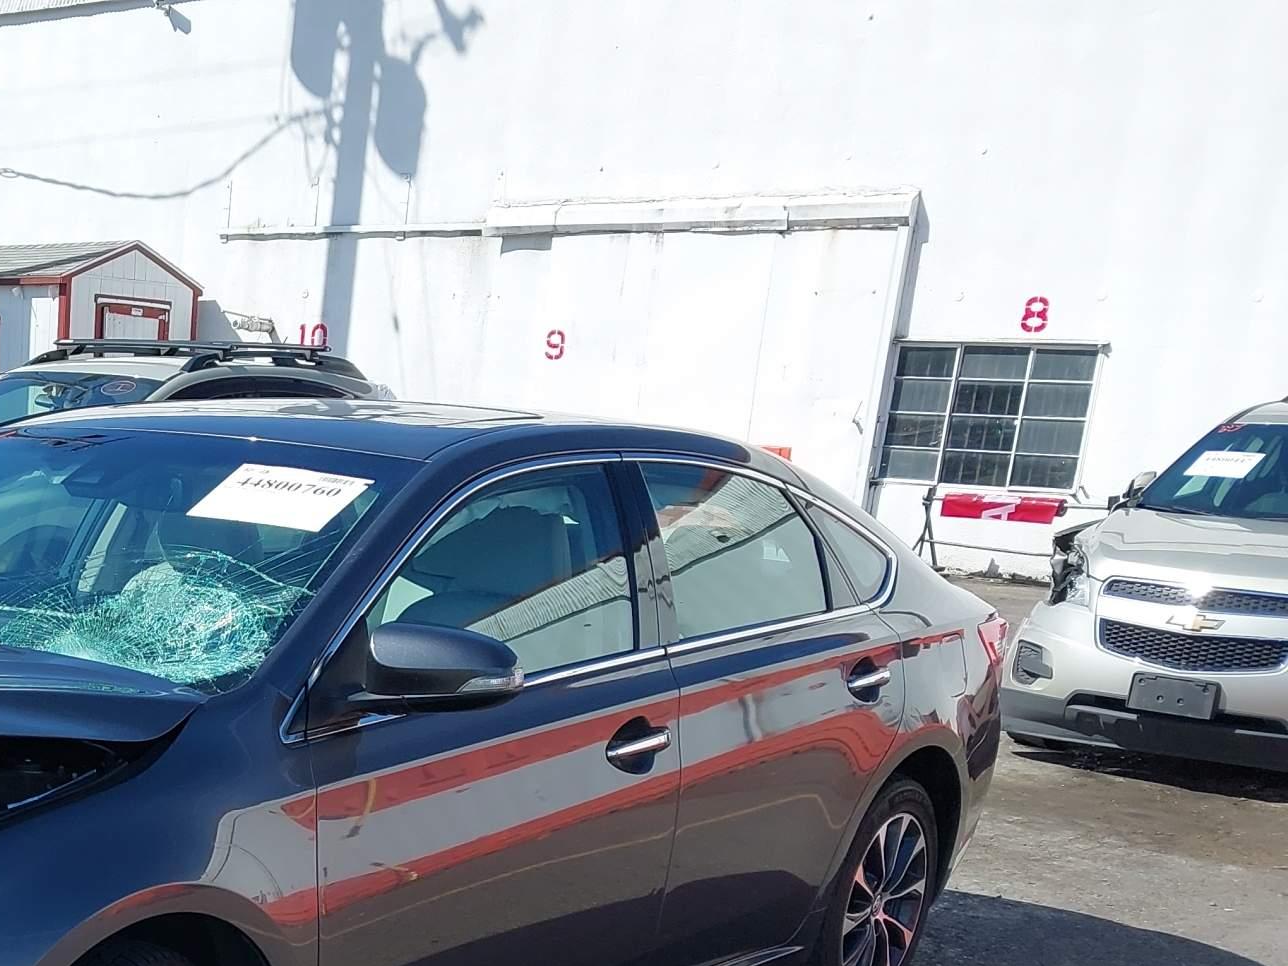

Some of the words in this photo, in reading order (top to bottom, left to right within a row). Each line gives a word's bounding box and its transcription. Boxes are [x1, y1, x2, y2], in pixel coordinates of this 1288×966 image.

[1021, 296, 1049, 332] 8
[300, 323, 327, 346] 10
[545, 329, 565, 360] 9
[236, 477, 342, 496] 44800760
